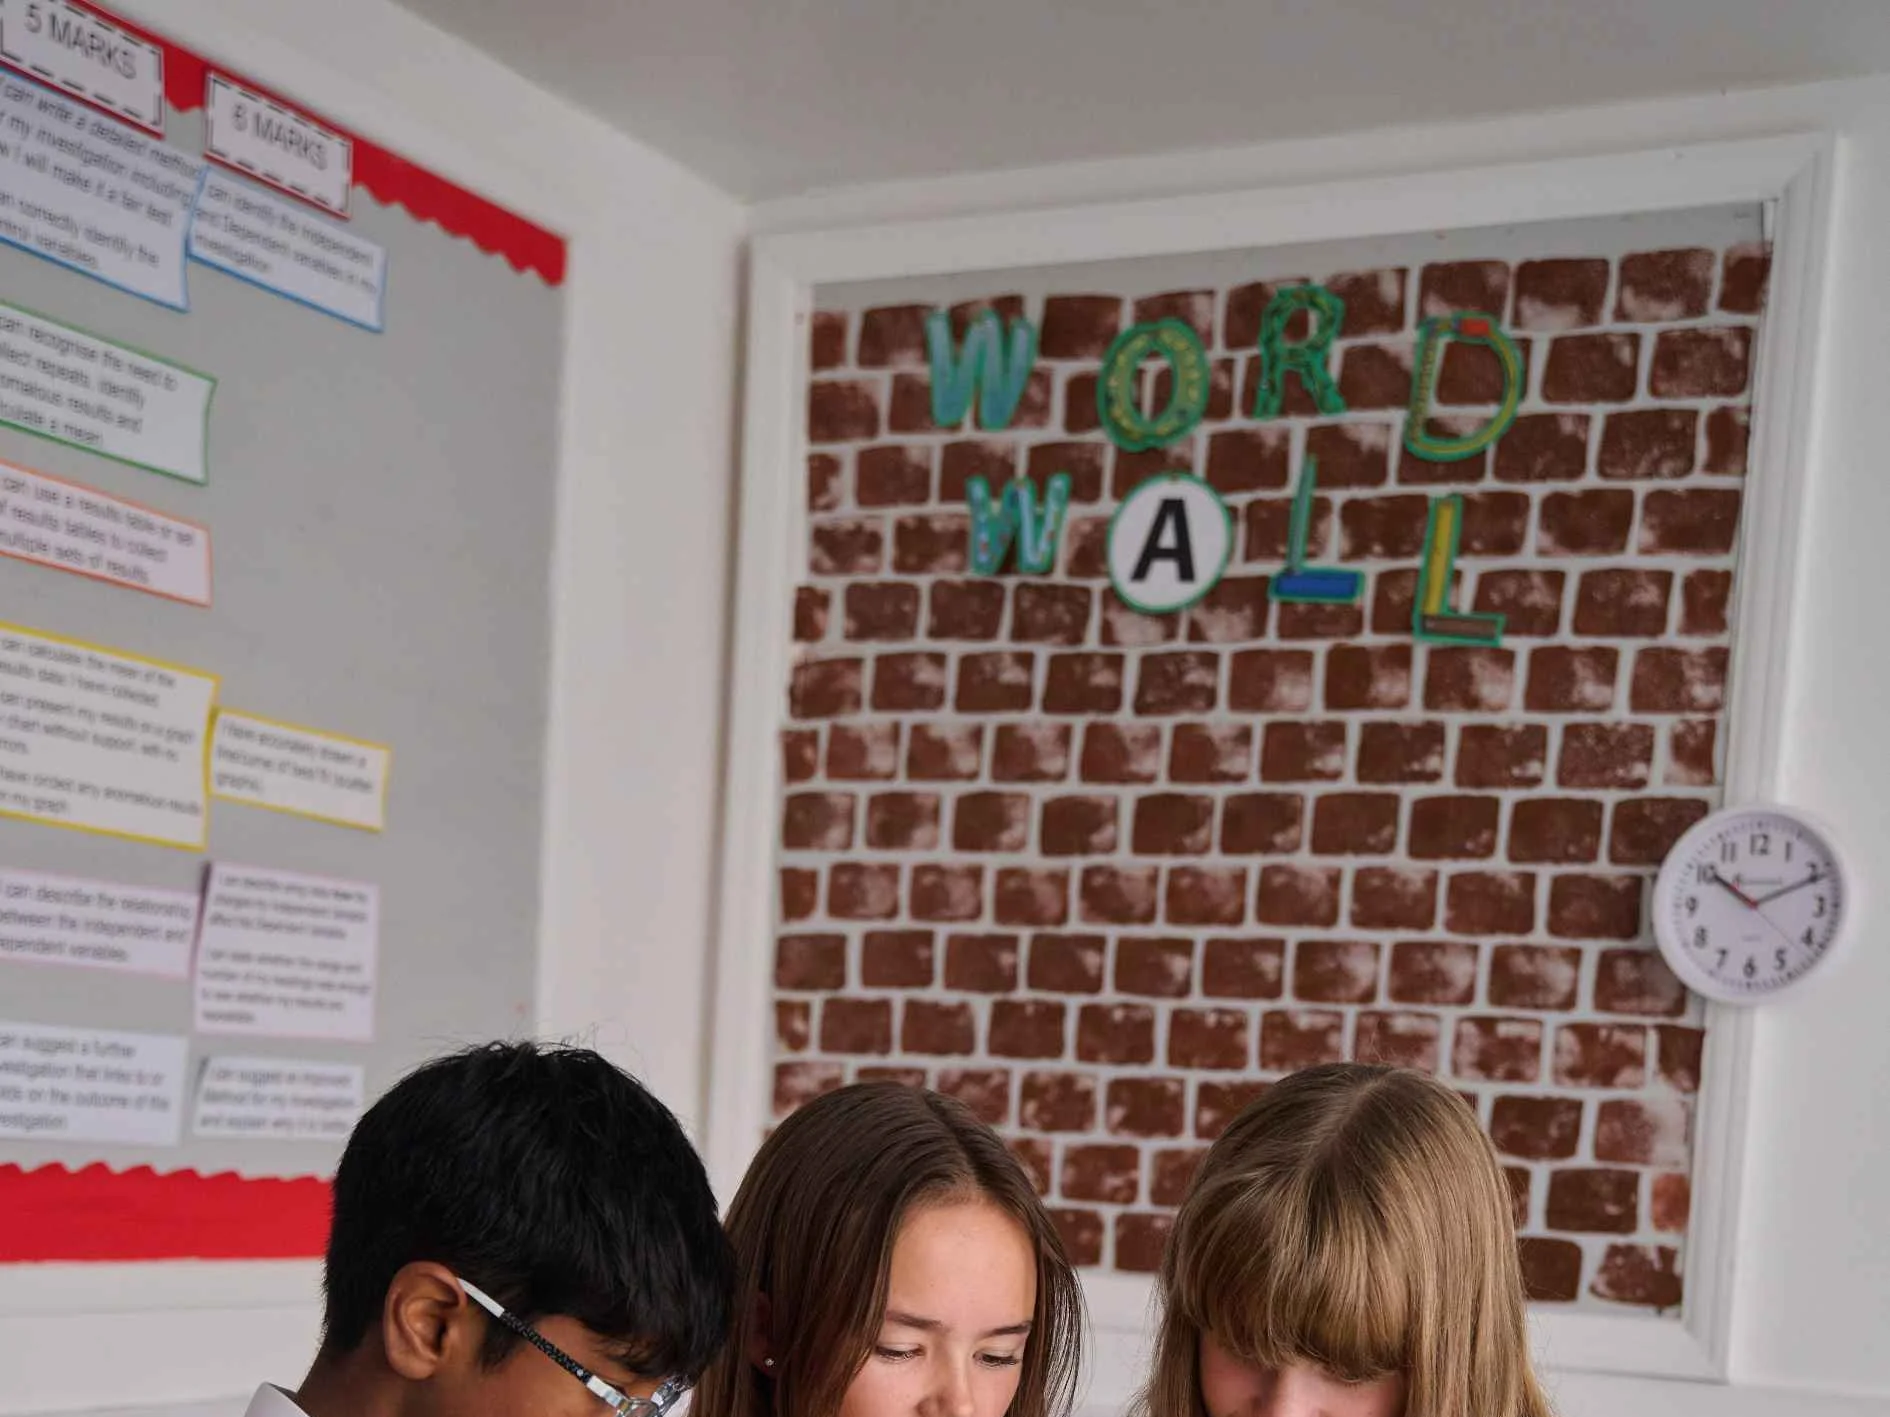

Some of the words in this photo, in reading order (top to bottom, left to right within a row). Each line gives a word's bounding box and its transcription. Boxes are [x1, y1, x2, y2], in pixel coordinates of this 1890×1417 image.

[24, 4, 42, 33] 5
[49, 12, 137, 80] MARKS
[252, 111, 328, 171] MARKS
[926, 284, 1524, 461] WORD
[966, 454, 1506, 646] WALL
[1721, 842, 1737, 863] 11
[1749, 833, 1769, 855] 12
[1686, 897, 1697, 919] 9
[1813, 896, 1825, 918] 3
[1716, 949, 1729, 969] 7
[1743, 957, 1756, 978] 6
[1774, 949, 1786, 970] 5
